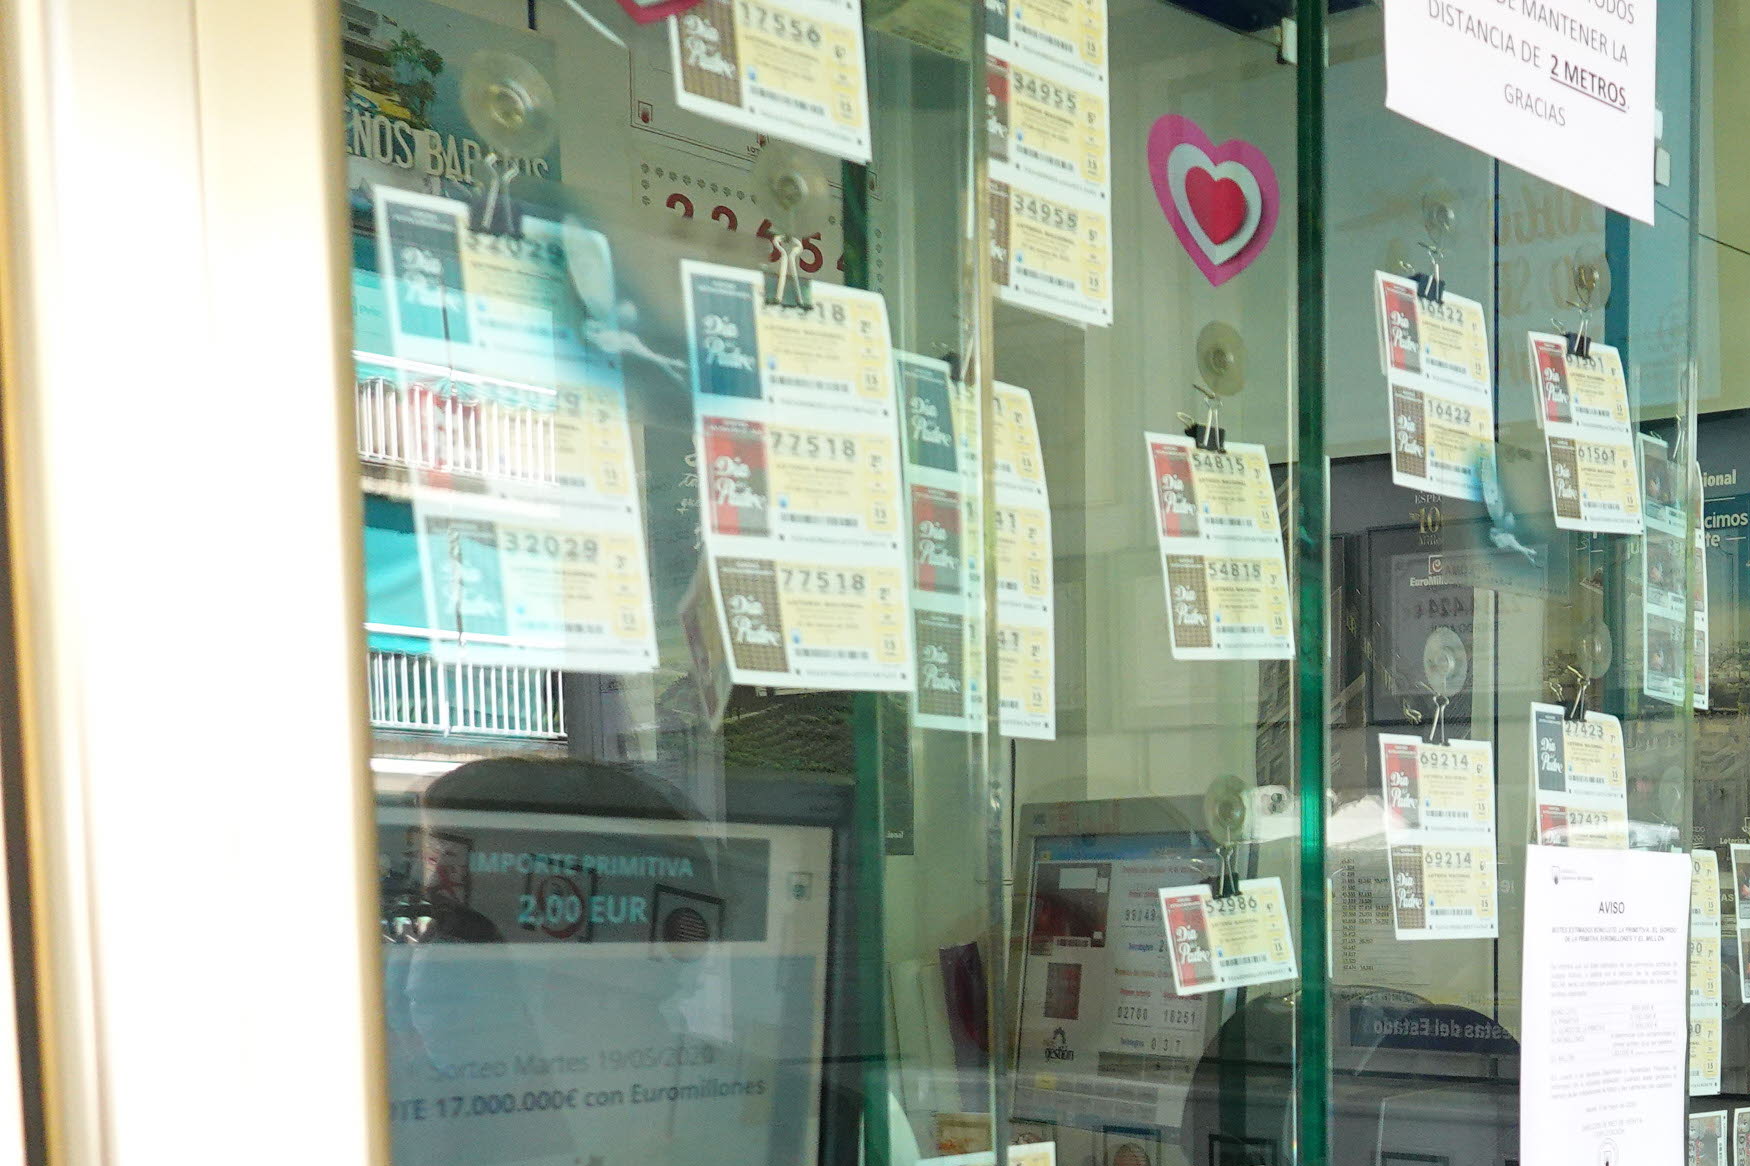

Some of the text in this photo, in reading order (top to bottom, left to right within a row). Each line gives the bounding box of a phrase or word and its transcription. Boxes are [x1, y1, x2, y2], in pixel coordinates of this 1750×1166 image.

[1429, 0, 1541, 69] DISTANCIA DE
[1522, 2, 1629, 65] MANTENER LA
[1550, 54, 1559, 77] 2
[1012, 68, 1078, 113] 34955
[1504, 83, 1566, 126] GRACIAS
[1012, 193, 1079, 229] 34955
[1427, 399, 1471, 424] 16422
[771, 430, 857, 458] 77518
[1578, 445, 1616, 466] 61561
[1192, 452, 1245, 474] 54815
[781, 568, 866, 595] 77518
[1208, 561, 1262, 580] 54815
[1565, 722, 1605, 737] 27423
[1420, 751, 1469, 767] 69214
[468, 850, 694, 878] IMPORTE PRIMITIVA
[1425, 852, 1472, 867] 69214
[517, 894, 650, 925] 2.00 EUR
[1205, 896, 1258, 914] 52986
[1599, 901, 1625, 914] AVISO
